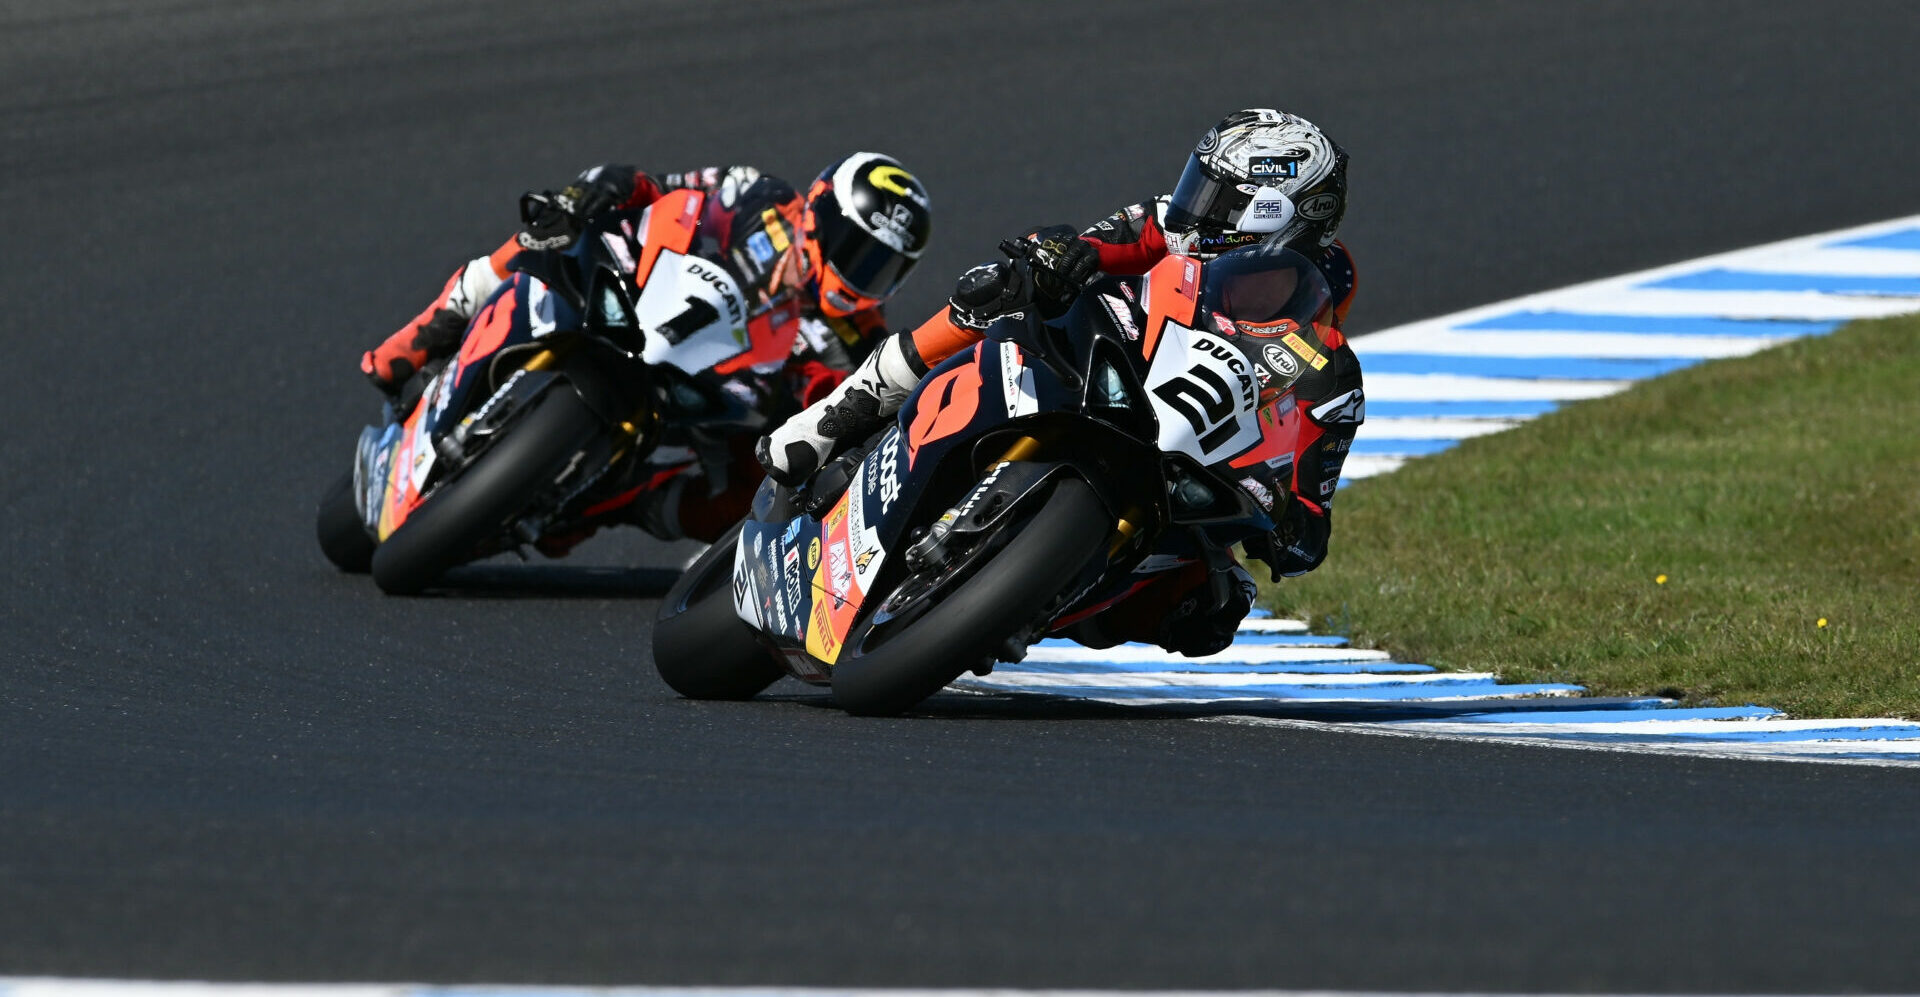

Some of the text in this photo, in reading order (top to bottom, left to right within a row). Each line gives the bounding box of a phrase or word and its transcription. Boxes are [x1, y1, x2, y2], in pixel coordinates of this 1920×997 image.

[1255, 201, 1279, 212] F45
[1303, 199, 1335, 214] Arai
[656, 295, 720, 346] 1
[687, 264, 742, 325] DUCATI
[1192, 338, 1255, 411] DUCATI
[1266, 349, 1294, 371] Arai
[1152, 364, 1241, 456] 21
[867, 451, 879, 496] mobile
[880, 430, 902, 515] boost
[961, 461, 1010, 517] PIRELLI
[775, 589, 787, 635] DUCATI
[786, 558, 800, 613] IPONE
[815, 599, 835, 657] PIRELLI
